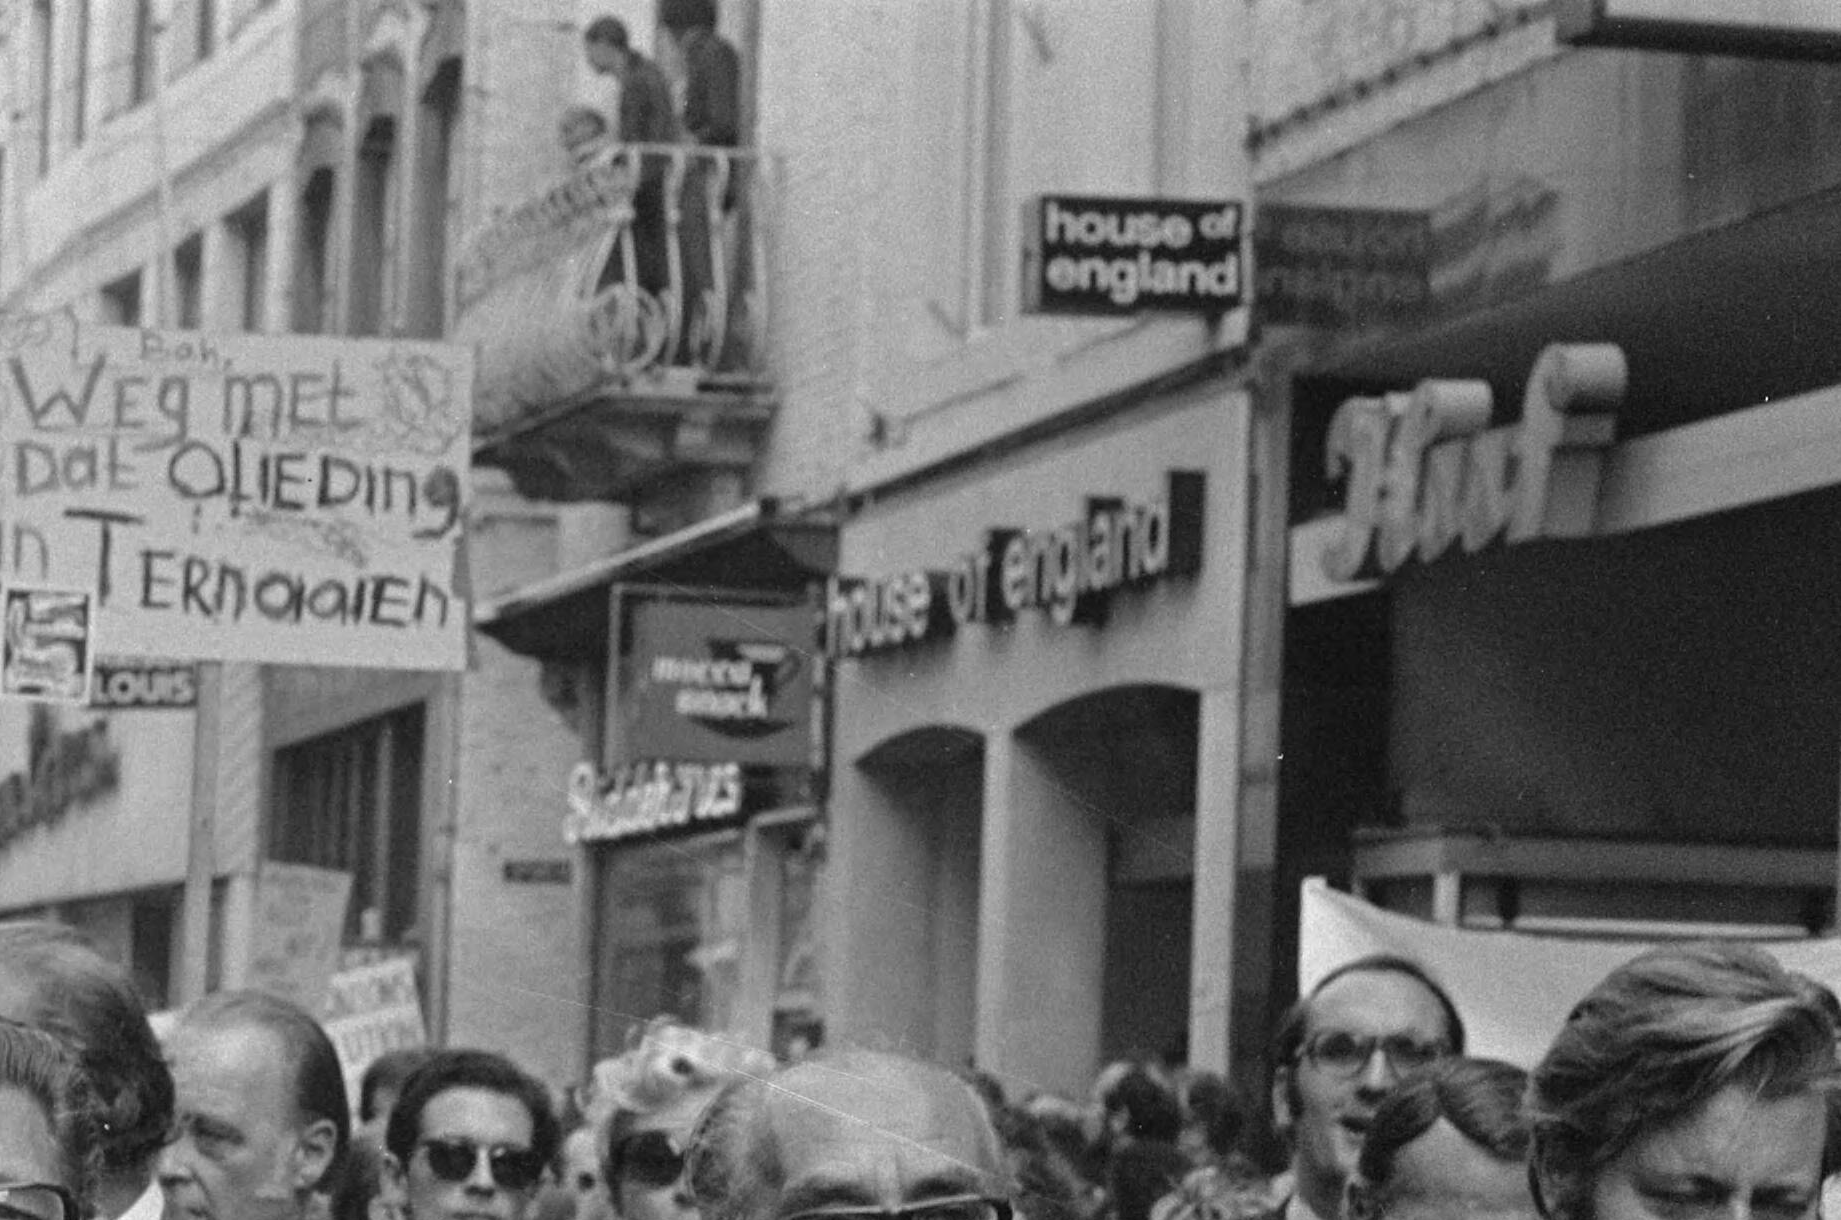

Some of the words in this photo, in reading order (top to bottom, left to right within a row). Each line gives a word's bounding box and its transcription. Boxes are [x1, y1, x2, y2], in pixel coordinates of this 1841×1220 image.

[1046, 202, 1192, 249] house
[1199, 206, 1237, 239] of
[1046, 250, 1238, 304] england
[827, 571, 930, 655] house
[948, 552, 991, 624] of
[1001, 474, 1176, 628] england
[92, 671, 195, 704] LOUIS
